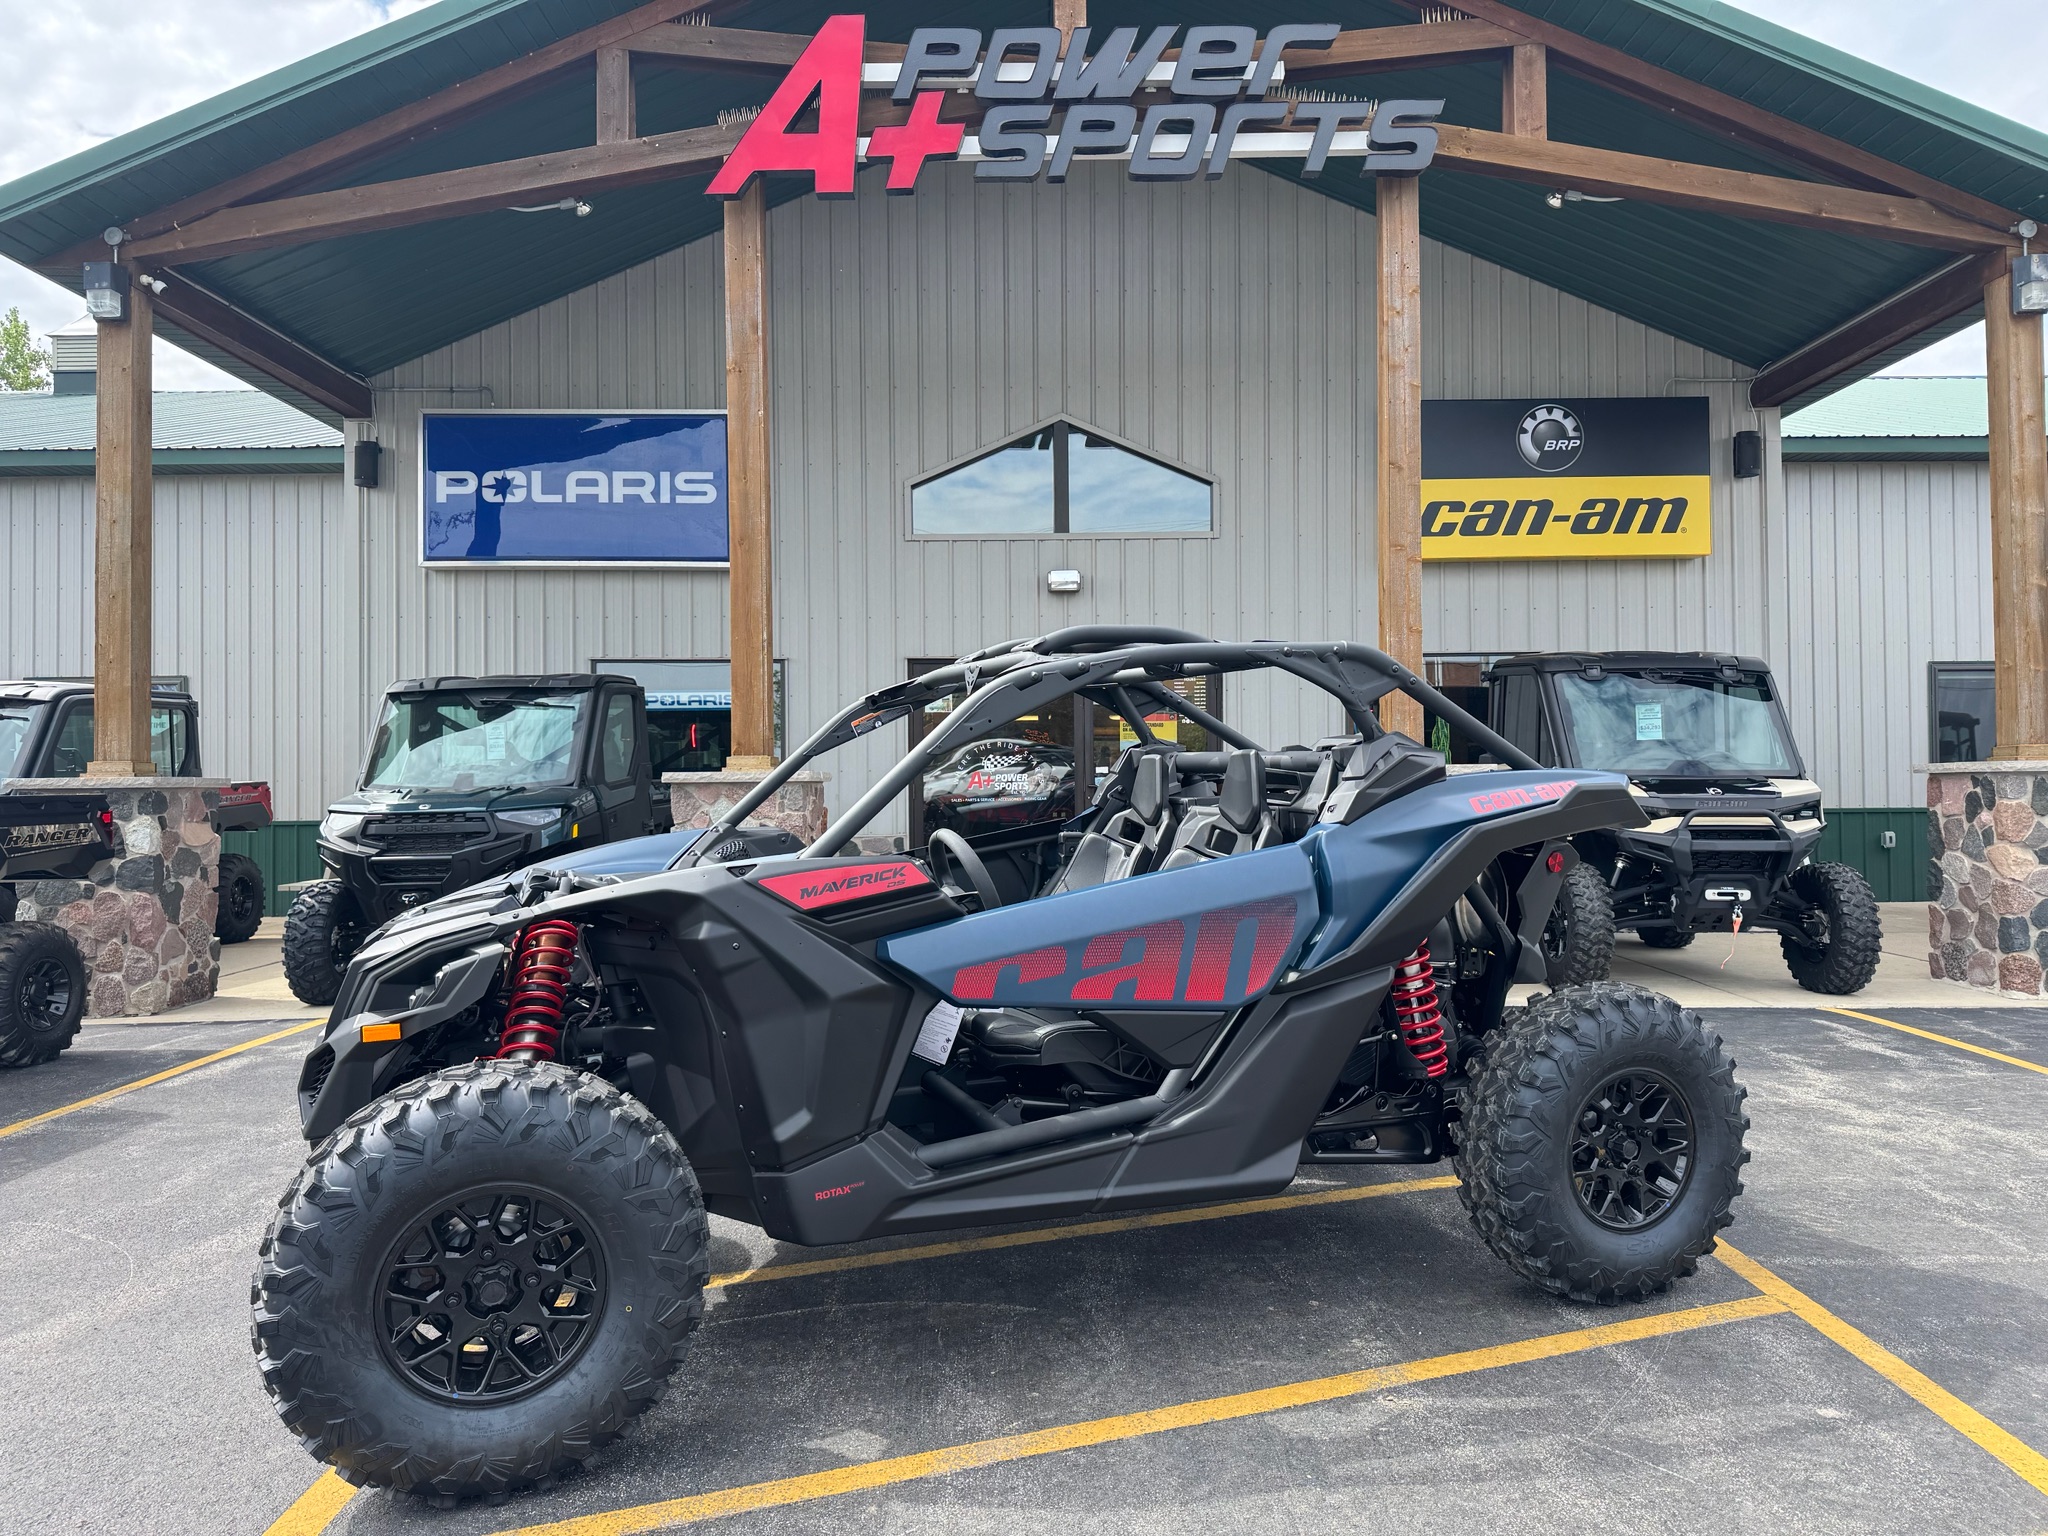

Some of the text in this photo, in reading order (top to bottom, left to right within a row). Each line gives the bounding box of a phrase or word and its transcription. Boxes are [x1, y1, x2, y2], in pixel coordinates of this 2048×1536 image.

[704, 14, 967, 202] A+
[1543, 439, 1581, 451] BRP
[435, 470, 718, 504] POLARIS
[1421, 496, 1689, 536] can-am
[974, 742, 992, 754] THE
[997, 741, 1020, 752] RIDE
[967, 770, 996, 790] A+
[995, 773, 1029, 781] POWER
[994, 781, 1030, 791] SPORTS
[4, 828, 92, 849] RANGER
[800, 866, 907, 900] MAVERICK
[886, 879, 906, 889] DS
[815, 1186, 851, 1201] ROTAX
